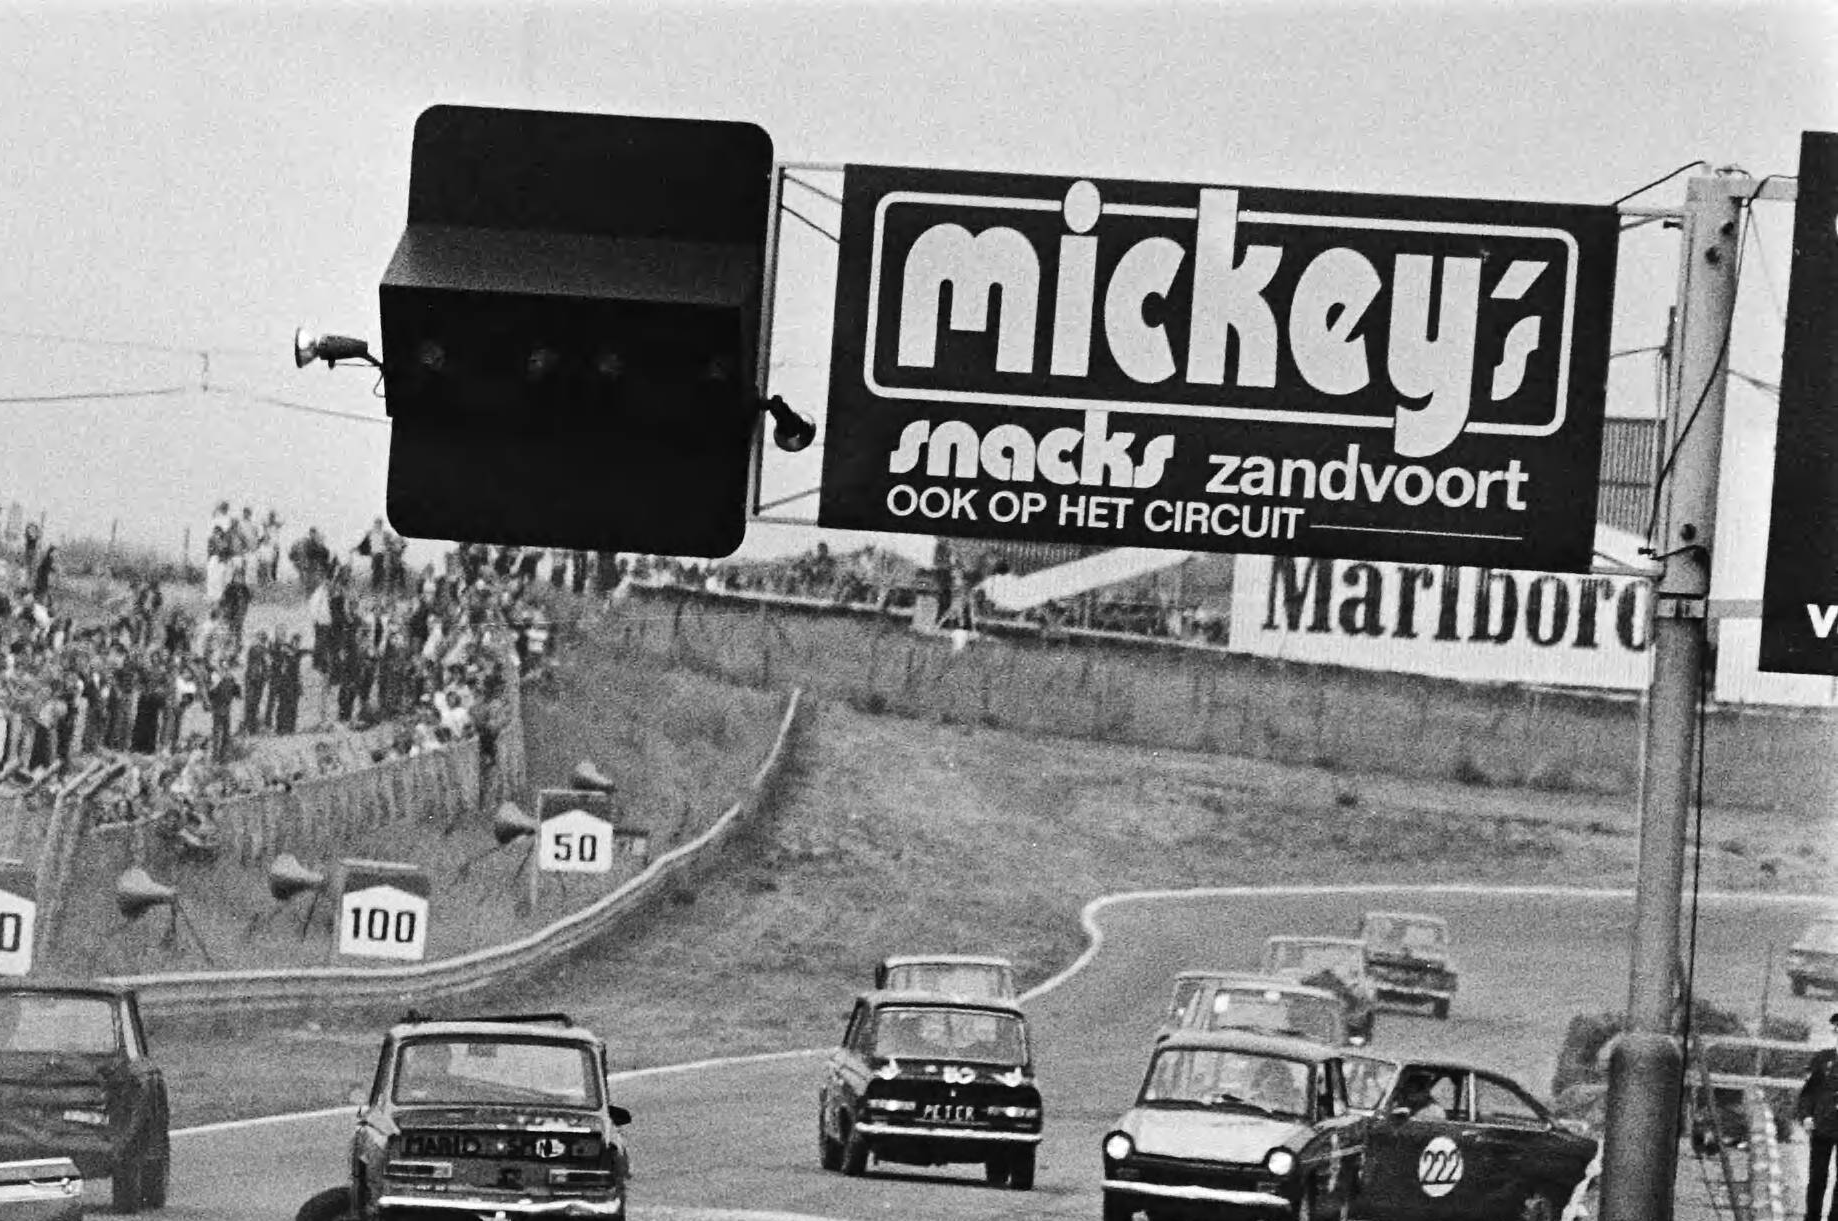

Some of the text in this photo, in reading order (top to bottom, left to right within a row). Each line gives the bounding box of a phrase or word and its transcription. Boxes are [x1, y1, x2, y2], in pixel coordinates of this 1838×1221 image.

[897, 180, 1549, 458] mickey's
[889, 409, 1530, 511] snacks zandvoort
[886, 484, 1306, 540] OOK OP HET CIRCUIT
[1261, 556, 1651, 652] Marlboro
[554, 833, 597, 862] 50
[352, 907, 417, 943] 100
[1422, 1148, 1460, 1186] 222
